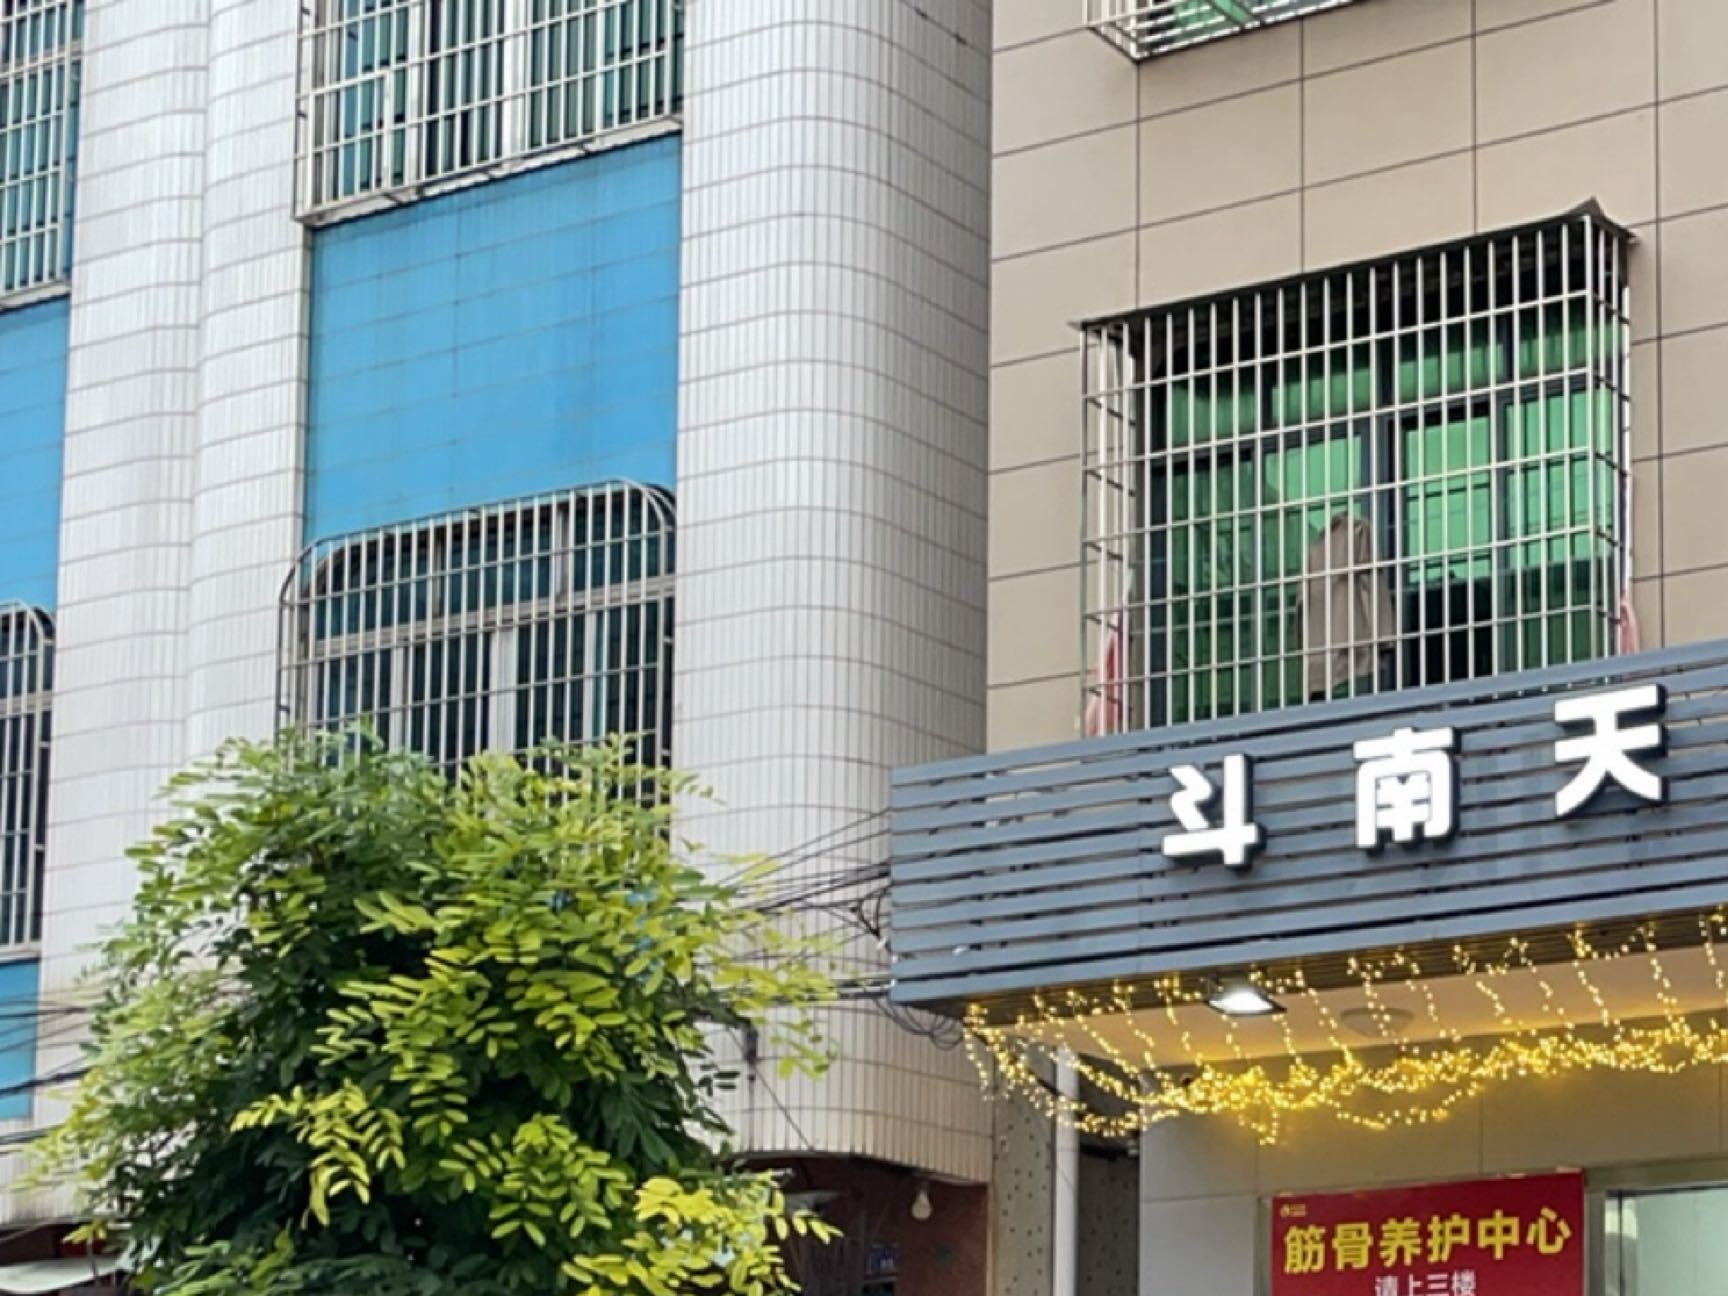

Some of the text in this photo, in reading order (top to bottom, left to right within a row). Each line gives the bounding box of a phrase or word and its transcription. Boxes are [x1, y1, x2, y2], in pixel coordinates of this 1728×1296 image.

[1283, 1206, 1572, 1275] 筋骨养护中心
